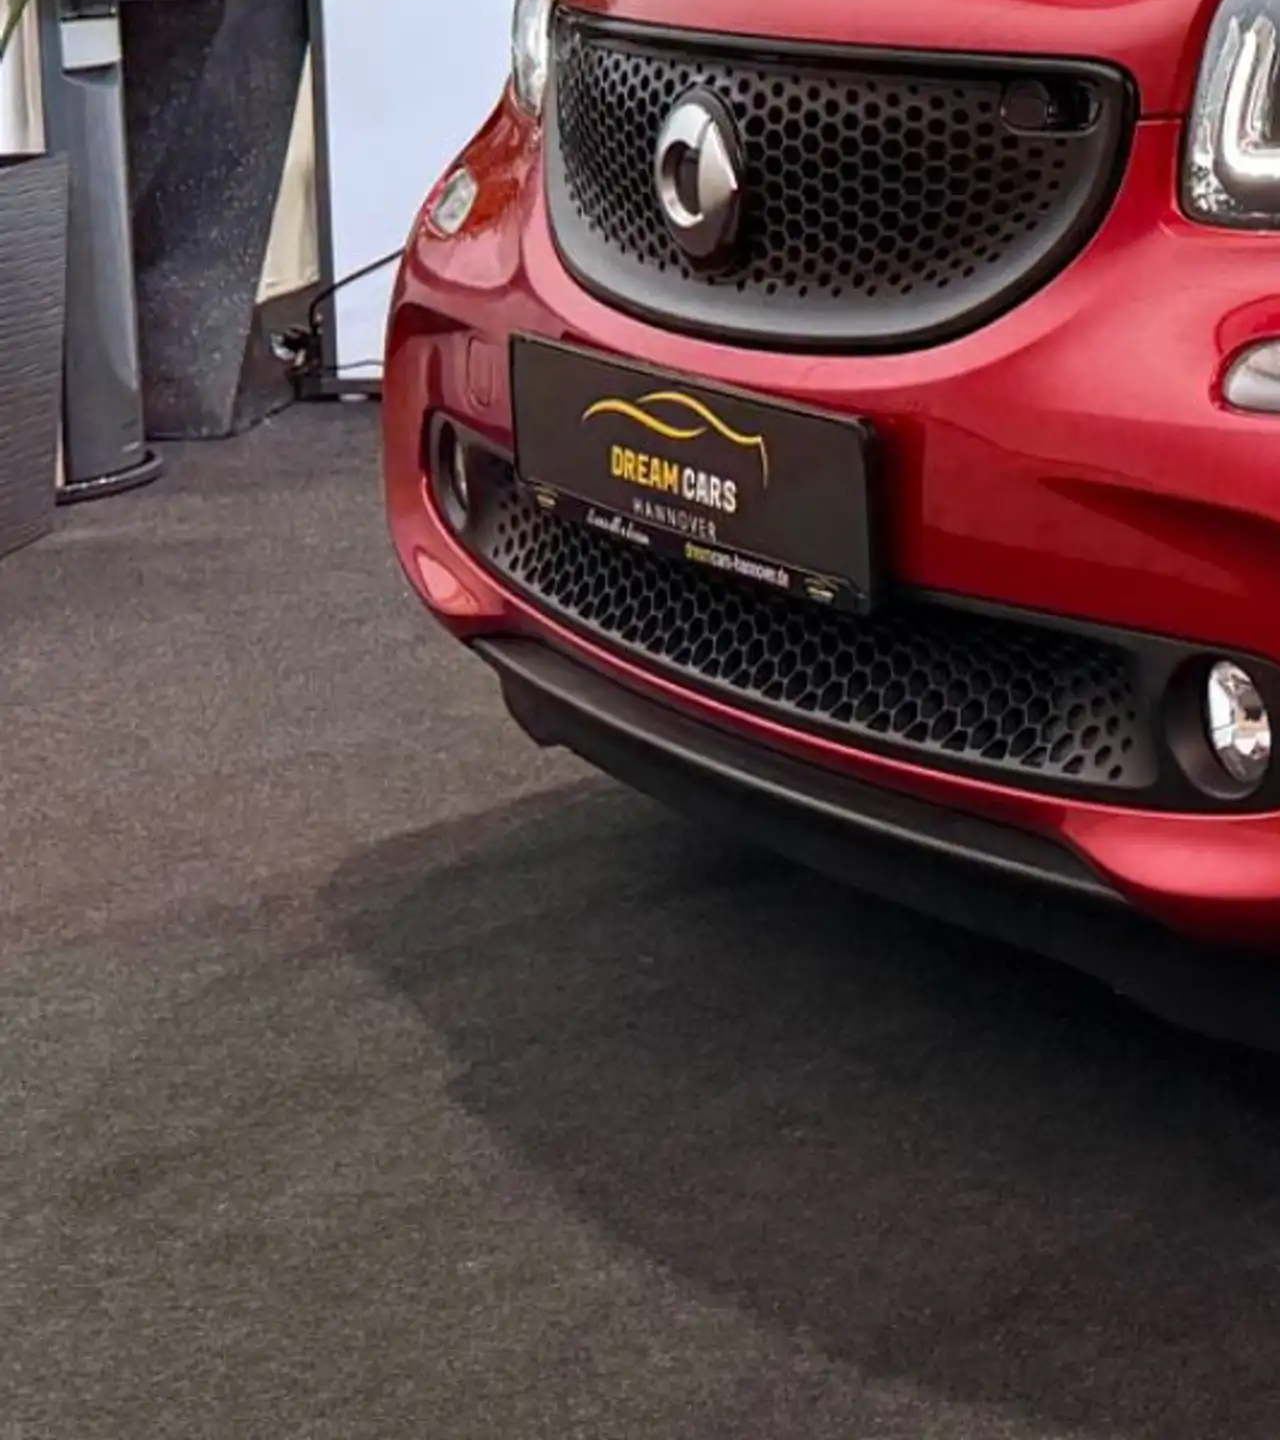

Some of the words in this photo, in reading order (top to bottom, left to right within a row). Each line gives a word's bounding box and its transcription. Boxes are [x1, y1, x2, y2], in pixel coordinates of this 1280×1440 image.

[611, 444, 679, 496] DREAM
[682, 466, 738, 514] CARS
[632, 496, 718, 545] HANNOVER
